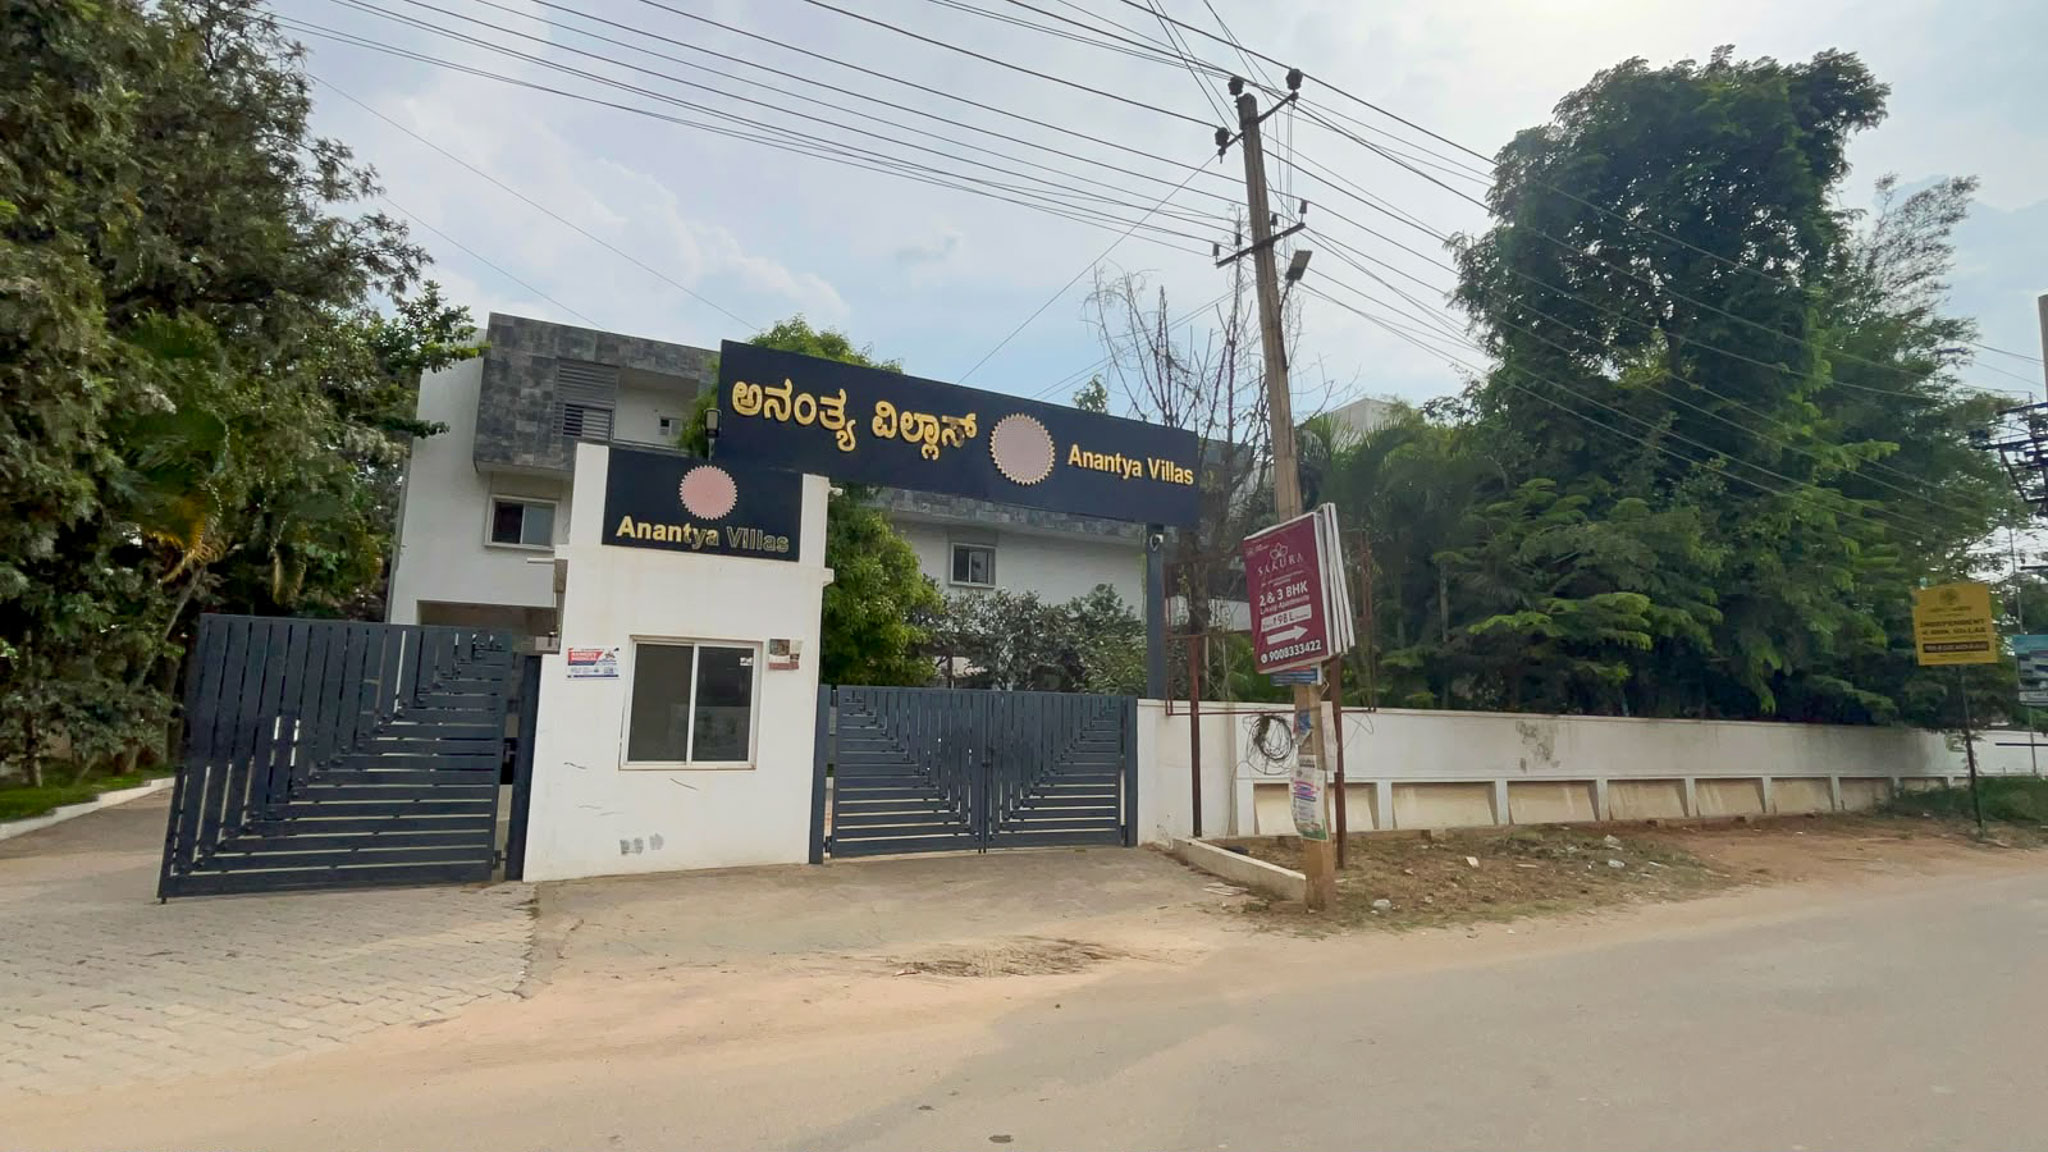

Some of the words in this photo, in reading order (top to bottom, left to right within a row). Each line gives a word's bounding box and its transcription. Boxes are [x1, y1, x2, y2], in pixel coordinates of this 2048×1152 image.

[732, 378, 856, 452] ಅನಂತ್ಯ
[872, 400, 977, 461] ವಿಲ್ಲಾಸ್
[1067, 443, 1142, 480] Anantya
[1147, 456, 1194, 485] Villas
[616, 515, 720, 549] Anantya
[726, 525, 790, 553] Villas
[1257, 552, 1304, 577] SAKURA
[1260, 594, 1267, 607] 2
[1266, 591, 1276, 604] &
[1276, 588, 1284, 601] 3
[1285, 580, 1308, 598] BHK
[1269, 639, 1321, 662] 9008333422
